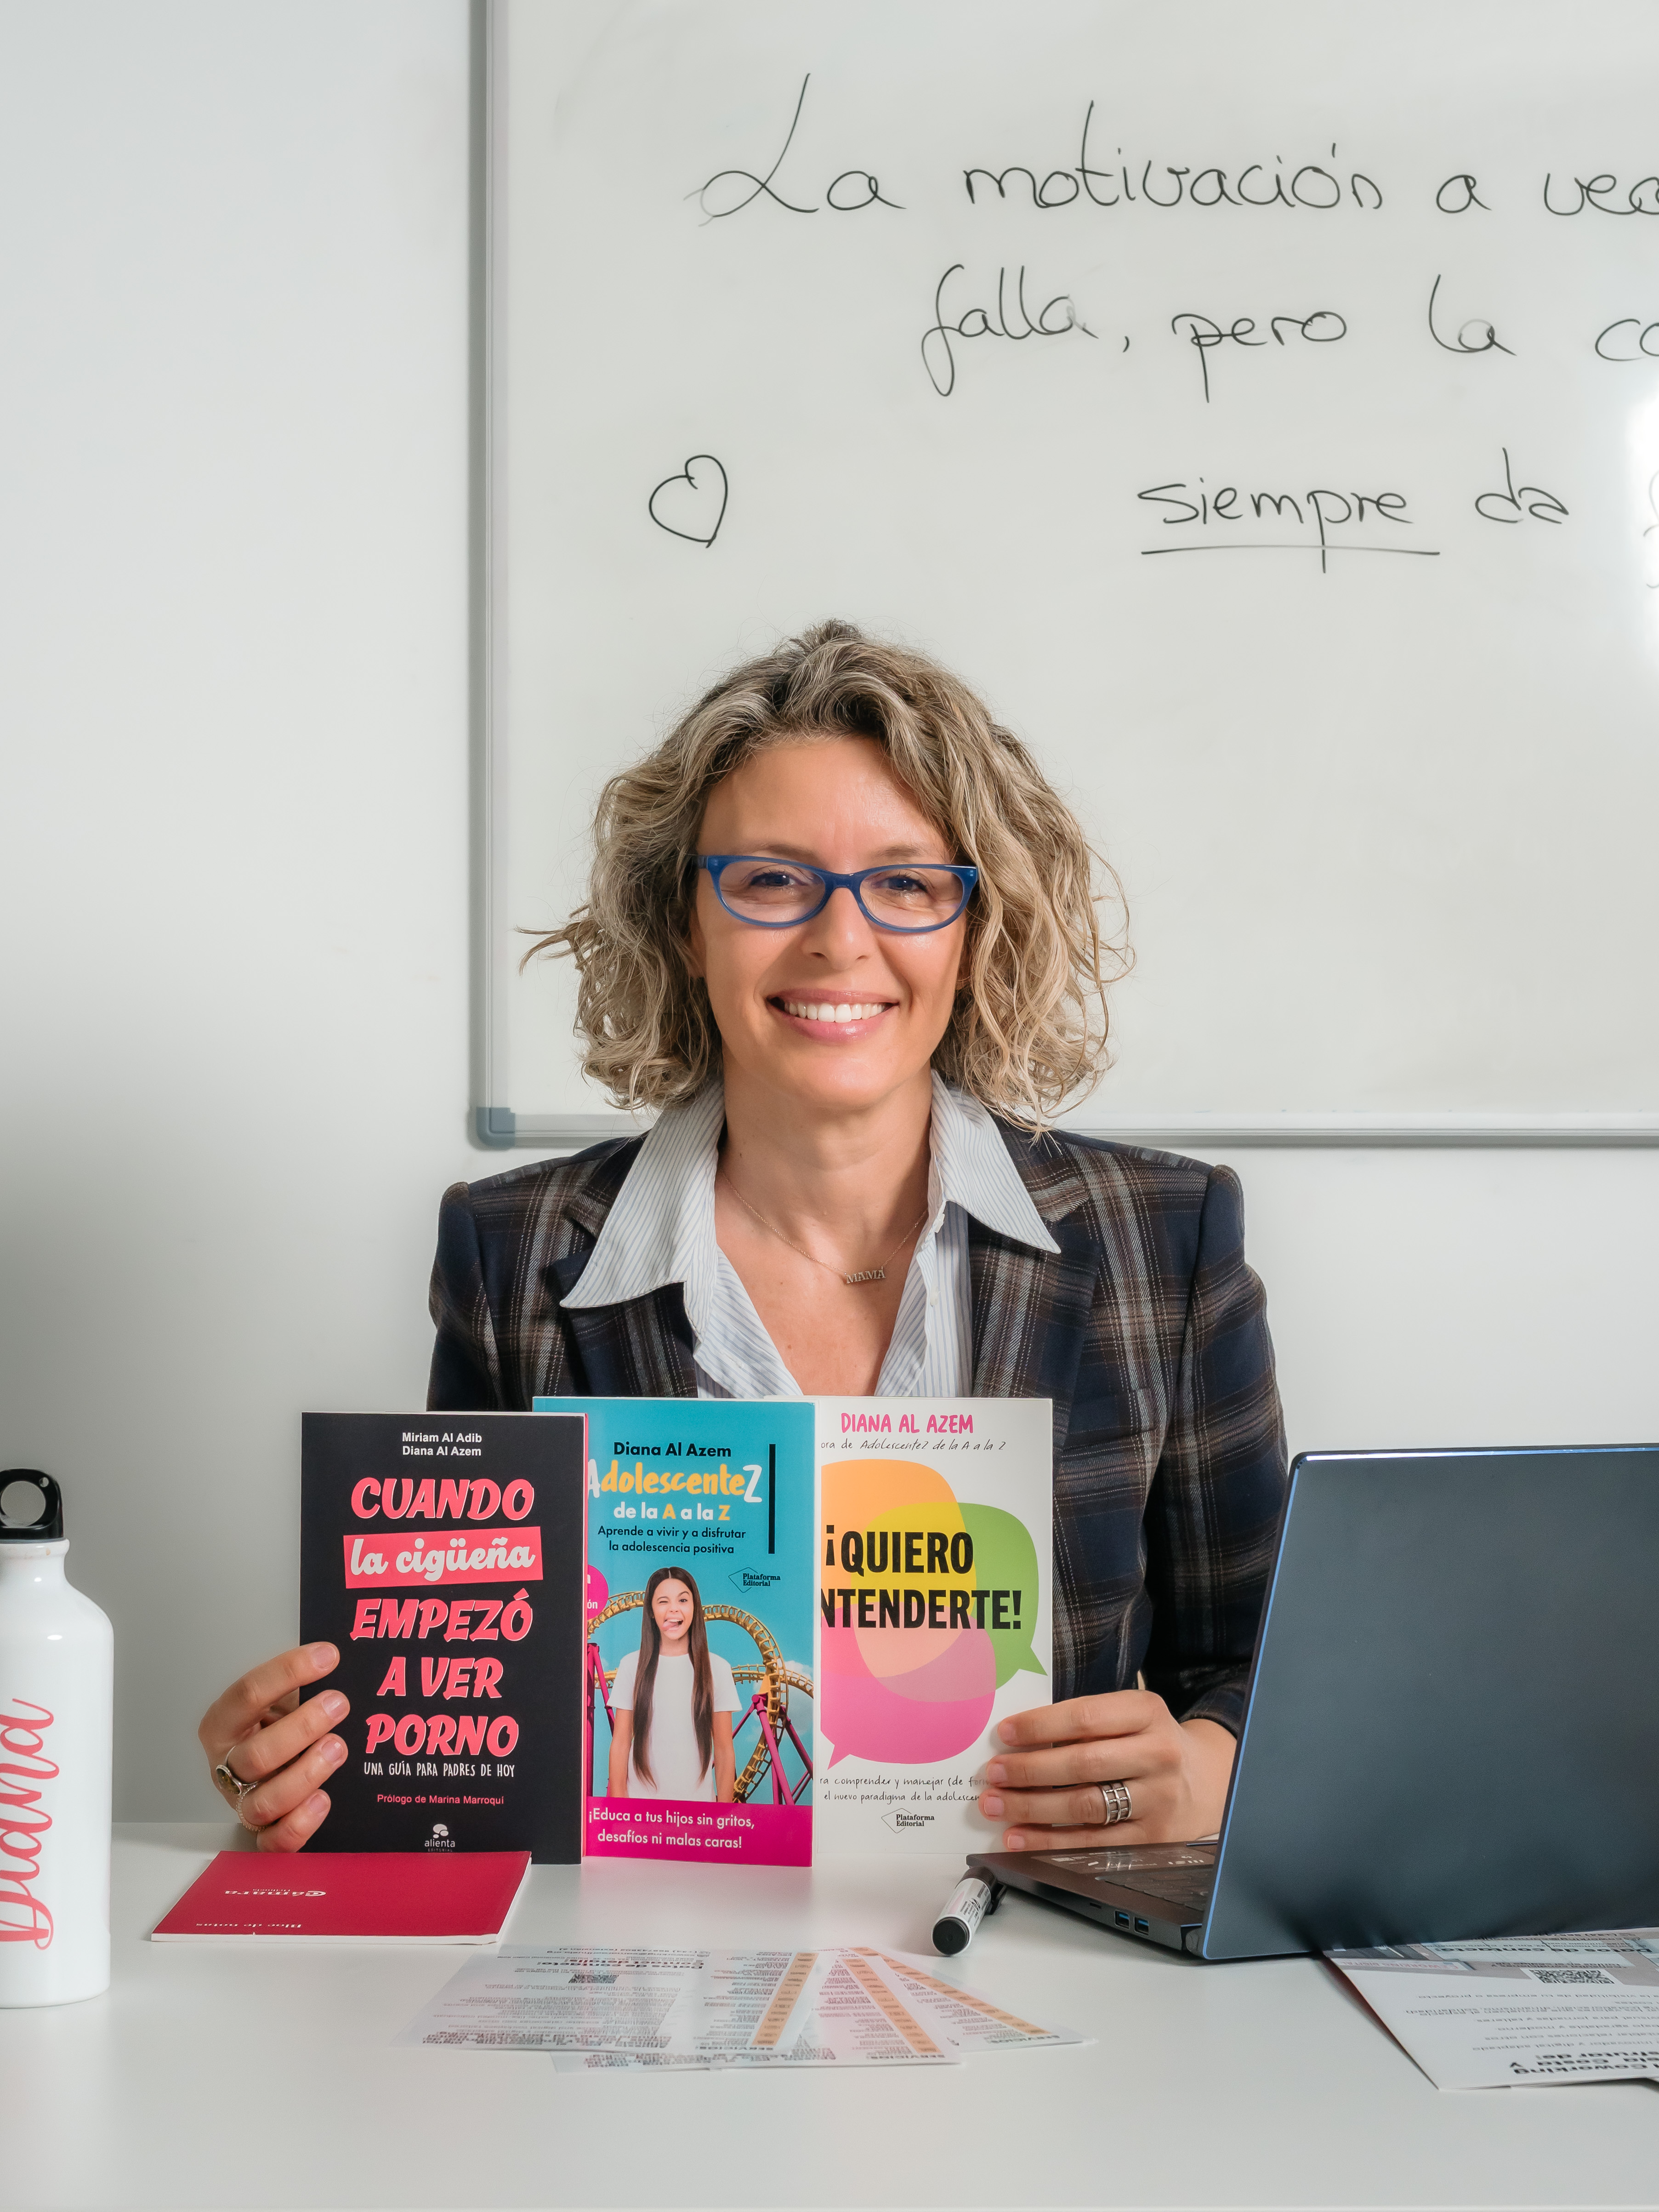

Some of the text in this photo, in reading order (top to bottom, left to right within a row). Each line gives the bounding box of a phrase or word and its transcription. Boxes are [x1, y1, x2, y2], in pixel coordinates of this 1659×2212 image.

[685, 74, 907, 226] La
[963, 100, 1382, 209] motivación
[1436, 175, 1490, 213] a
[921, 264, 1130, 397] falla,
[1171, 312, 1347, 403] pero
[1429, 274, 1516, 355] la
[1137, 448, 1569, 572] siempre da
[841, 1413, 973, 1433] DIANA AL AZEM
[403, 1433, 482, 1442] Miriam Al Adib
[841, 1439, 852, 1448] de
[933, 1439, 945, 1450] de
[949, 1439, 958, 1450] la
[984, 1439, 993, 1450] la
[403, 1446, 481, 1456] Diana Al Azem
[614, 1442, 731, 1457] Diana Al Azem
[351, 1477, 534, 1520] CUANDO
[614, 1501, 730, 1520] de la A a la Z
[598, 1526, 643, 1537] Aprende
[657, 1527, 679, 1536] vivir
[682, 1530, 688, 1540] y
[702, 1527, 746, 1538] disfrutar
[609, 1541, 733, 1555] la adolescencia positiva
[826, 1525, 973, 1576] ¡QUIERO
[351, 1537, 535, 1581] la cigüeña
[743, 1573, 780, 1581] Plataforma
[350, 1588, 533, 1642] EMPEZÓ
[376, 1656, 503, 1700] A VER
[366, 1713, 519, 1757] PORNO
[364, 1761, 514, 1777] UNA GUÍA PARA PADRES DE HOY
[835, 1775, 891, 1789] comprender
[895, 1780, 899, 1789] y
[904, 1779, 943, 1790] manejar
[949, 1775, 962, 1786] (de
[378, 1794, 412, 1804] Prólogo
[429, 1795, 460, 1803] Marina
[464, 1796, 503, 1806] Marroquí
[824, 1791, 830, 1799] el
[861, 1791, 905, 1804] paradigma
[911, 1791, 920, 1800] de
[925, 1791, 932, 1800] la
[590, 1808, 630, 1823] ¡Educa
[646, 1812, 662, 1822] tus
[667, 1810, 693, 1827] hijos
[697, 1814, 712, 1825] sin
[717, 1814, 754, 1829] gritos,
[425, 1839, 455, 1847] alienta
[598, 1829, 741, 1848] desafíos ni malas caras!
